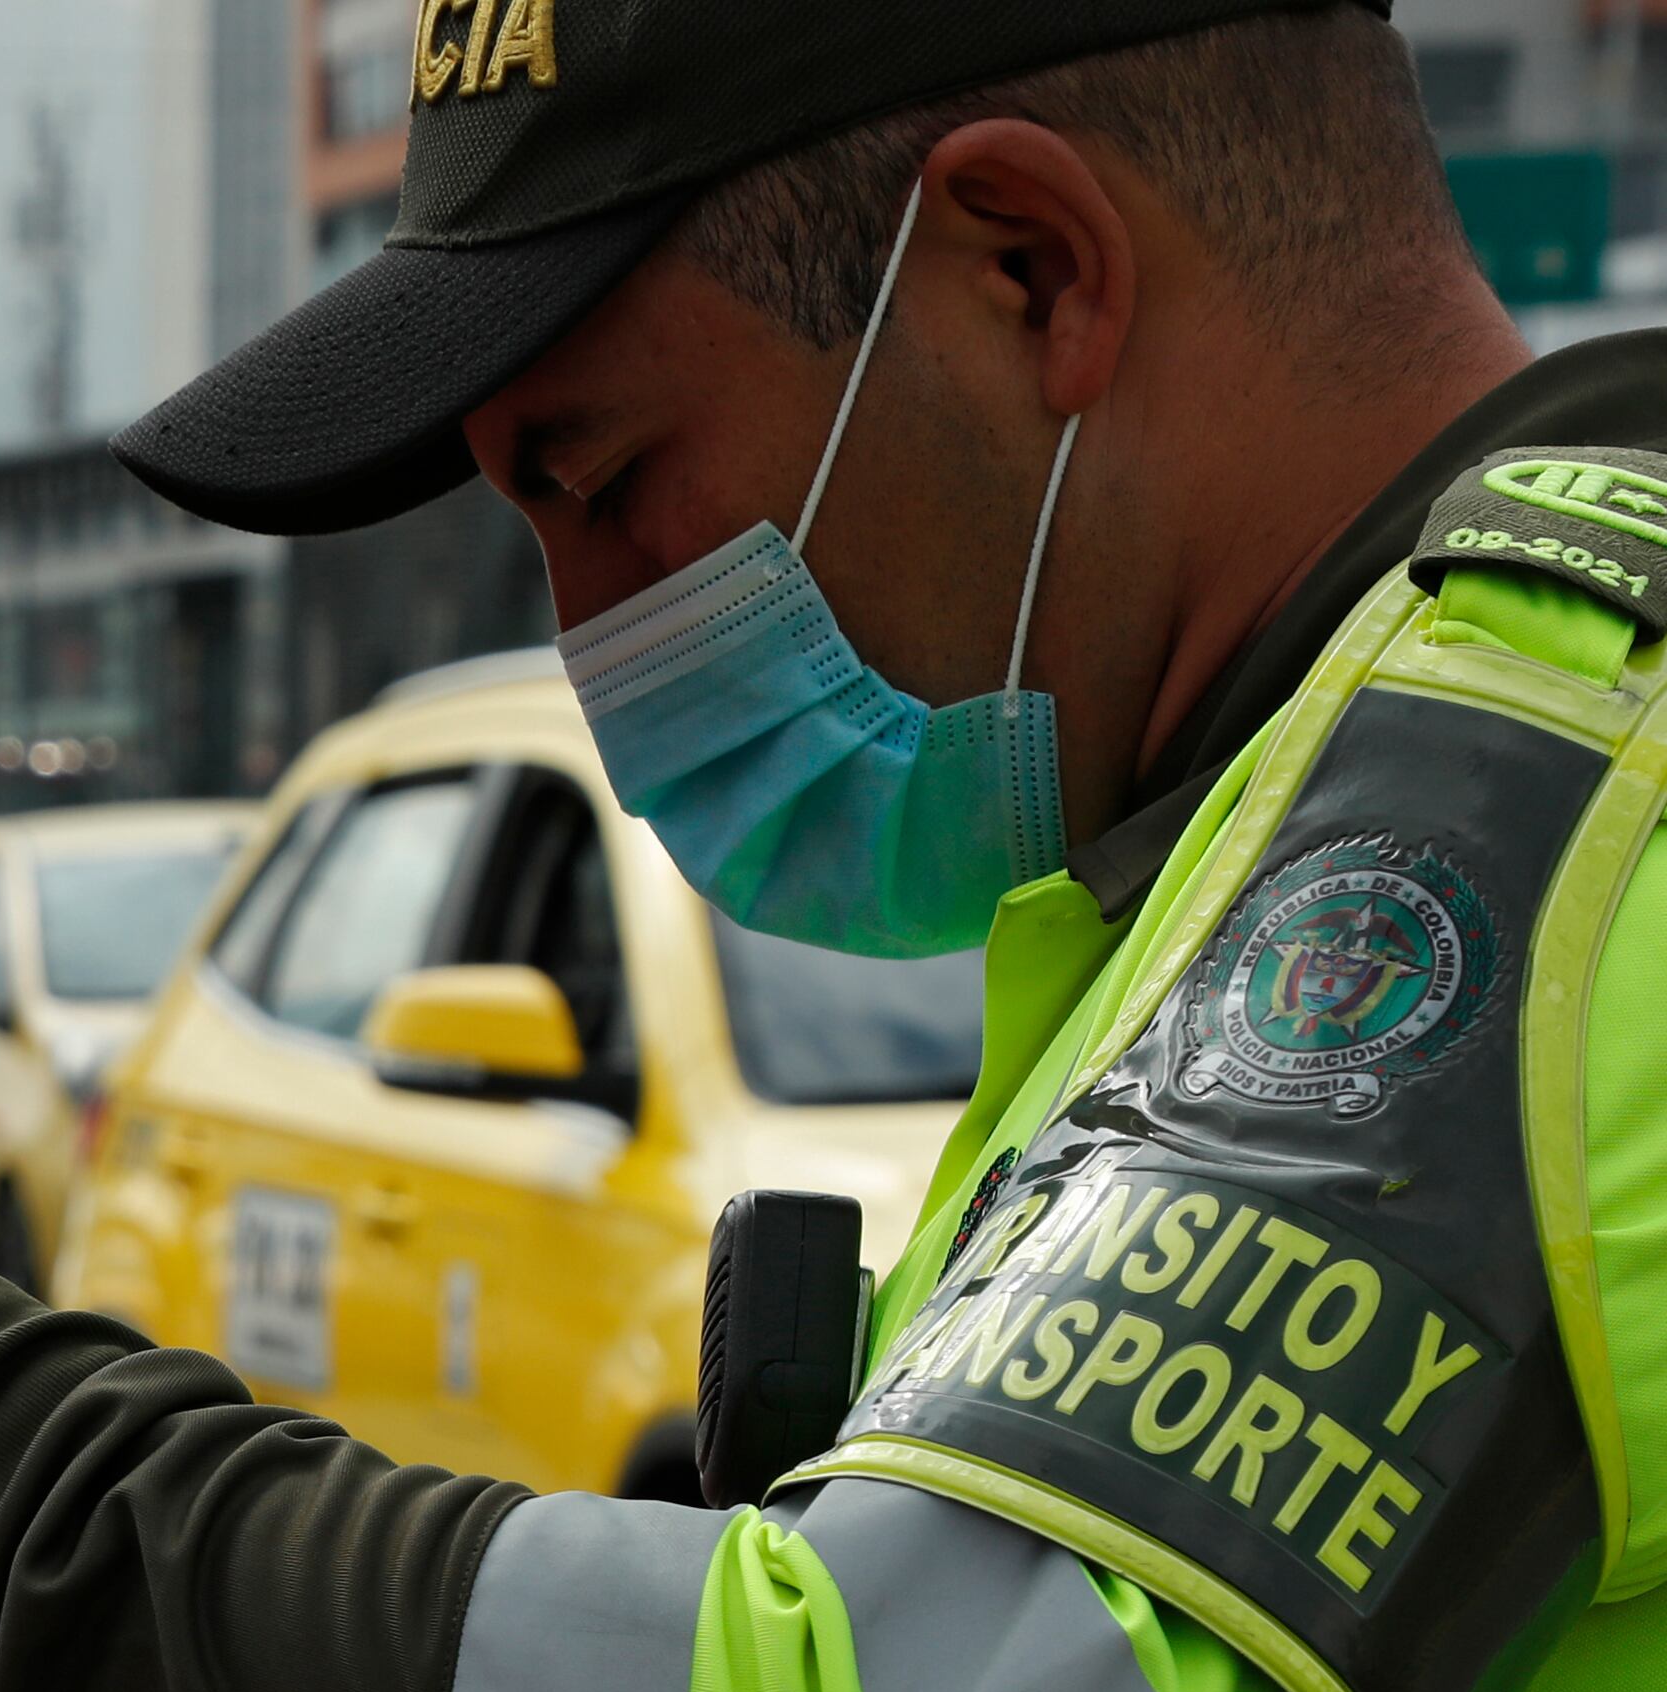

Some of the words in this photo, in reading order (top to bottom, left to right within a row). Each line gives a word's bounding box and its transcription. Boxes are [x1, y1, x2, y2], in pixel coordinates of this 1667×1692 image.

[411, 0, 557, 101] CIA
[1240, 878, 1352, 969] REPÚBLICA
[1370, 876, 1404, 894] DE
[1414, 899, 1456, 1003] COLOMBIA
[1216, 1059, 1255, 1090] DIOS
[1256, 1082, 1274, 1096] Y
[1275, 1076, 1358, 1098] PATRIA
[1225, 1009, 1272, 1065] POLICÍA
[1292, 1028, 1415, 1070] NACIONAL
[1383, 1310, 1483, 1437] Y
